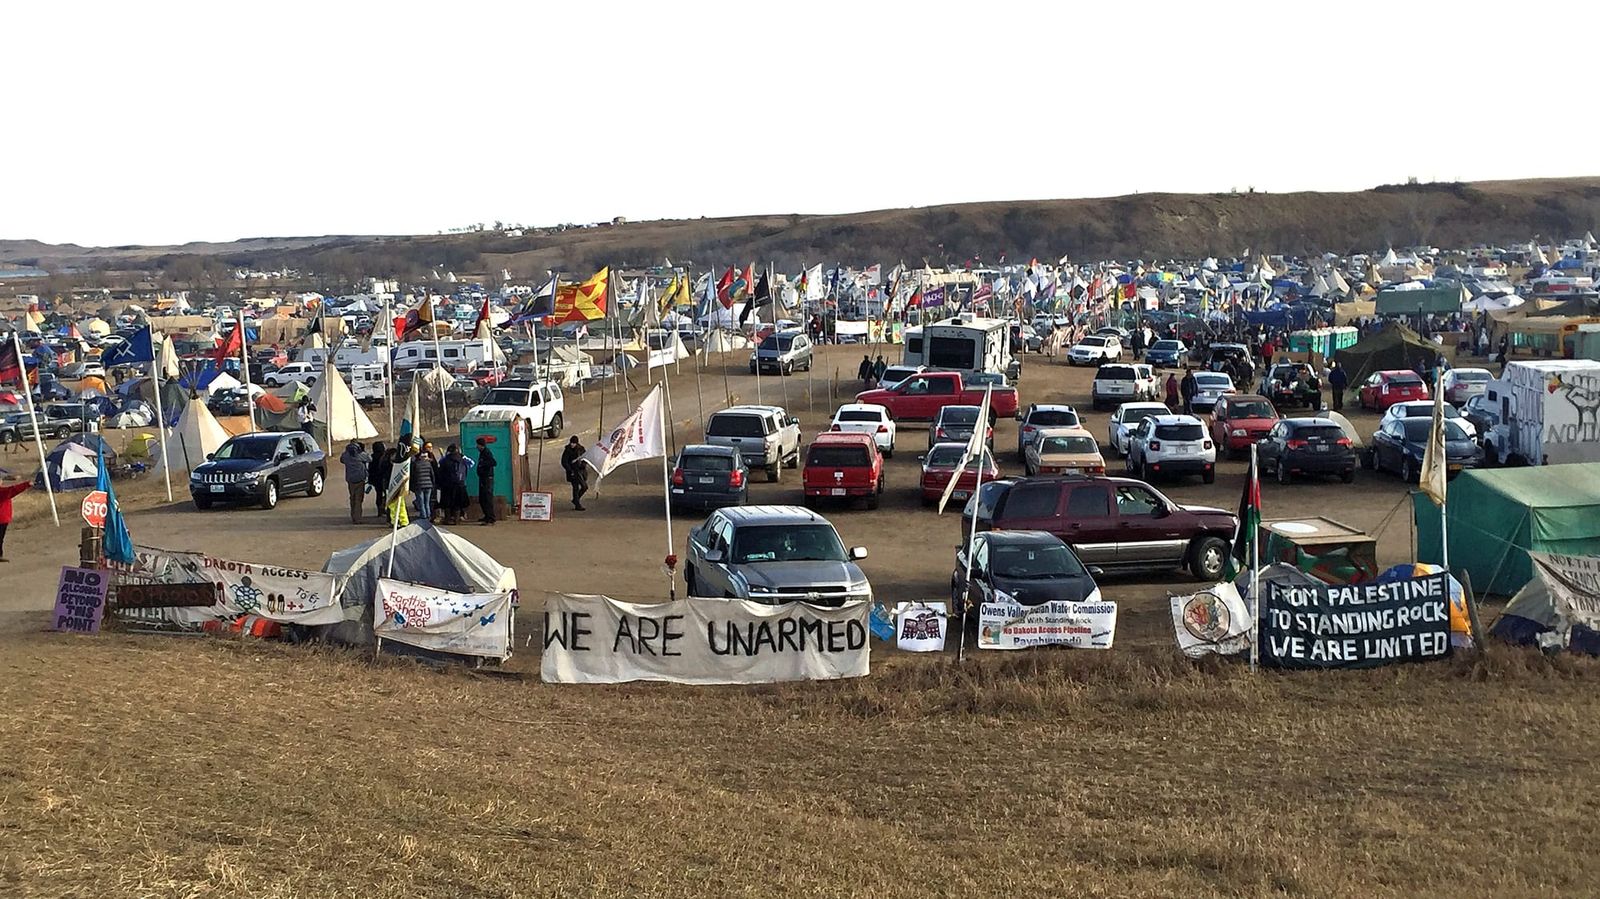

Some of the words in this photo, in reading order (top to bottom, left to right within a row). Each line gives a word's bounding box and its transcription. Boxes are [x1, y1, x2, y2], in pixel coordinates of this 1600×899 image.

[84, 502, 108, 516] STO
[204, 558, 252, 575] DAKOTA
[261, 567, 310, 580] ACCESS
[65, 570, 101, 586] NO
[1271, 583, 1318, 607] FROM
[1327, 577, 1442, 606] PALESTINE
[60, 593, 102, 608] BEYOND
[65, 604, 95, 618] THIS
[981, 604, 1005, 617] Owens
[1007, 606, 1029, 619] Valley
[1051, 602, 1070, 614] Water
[1072, 602, 1114, 614] Commission
[57, 615, 95, 631] POINT
[1269, 608, 1292, 630] TO
[1296, 609, 1395, 635] STANDING
[544, 612, 592, 651] WE
[613, 614, 684, 657] ARE
[707, 617, 866, 656] UNARMED
[1063, 626, 1092, 635] Pipeline
[1270, 635, 1305, 658] WE
[1310, 639, 1358, 661] ARE
[1364, 631, 1447, 659] UNITED
